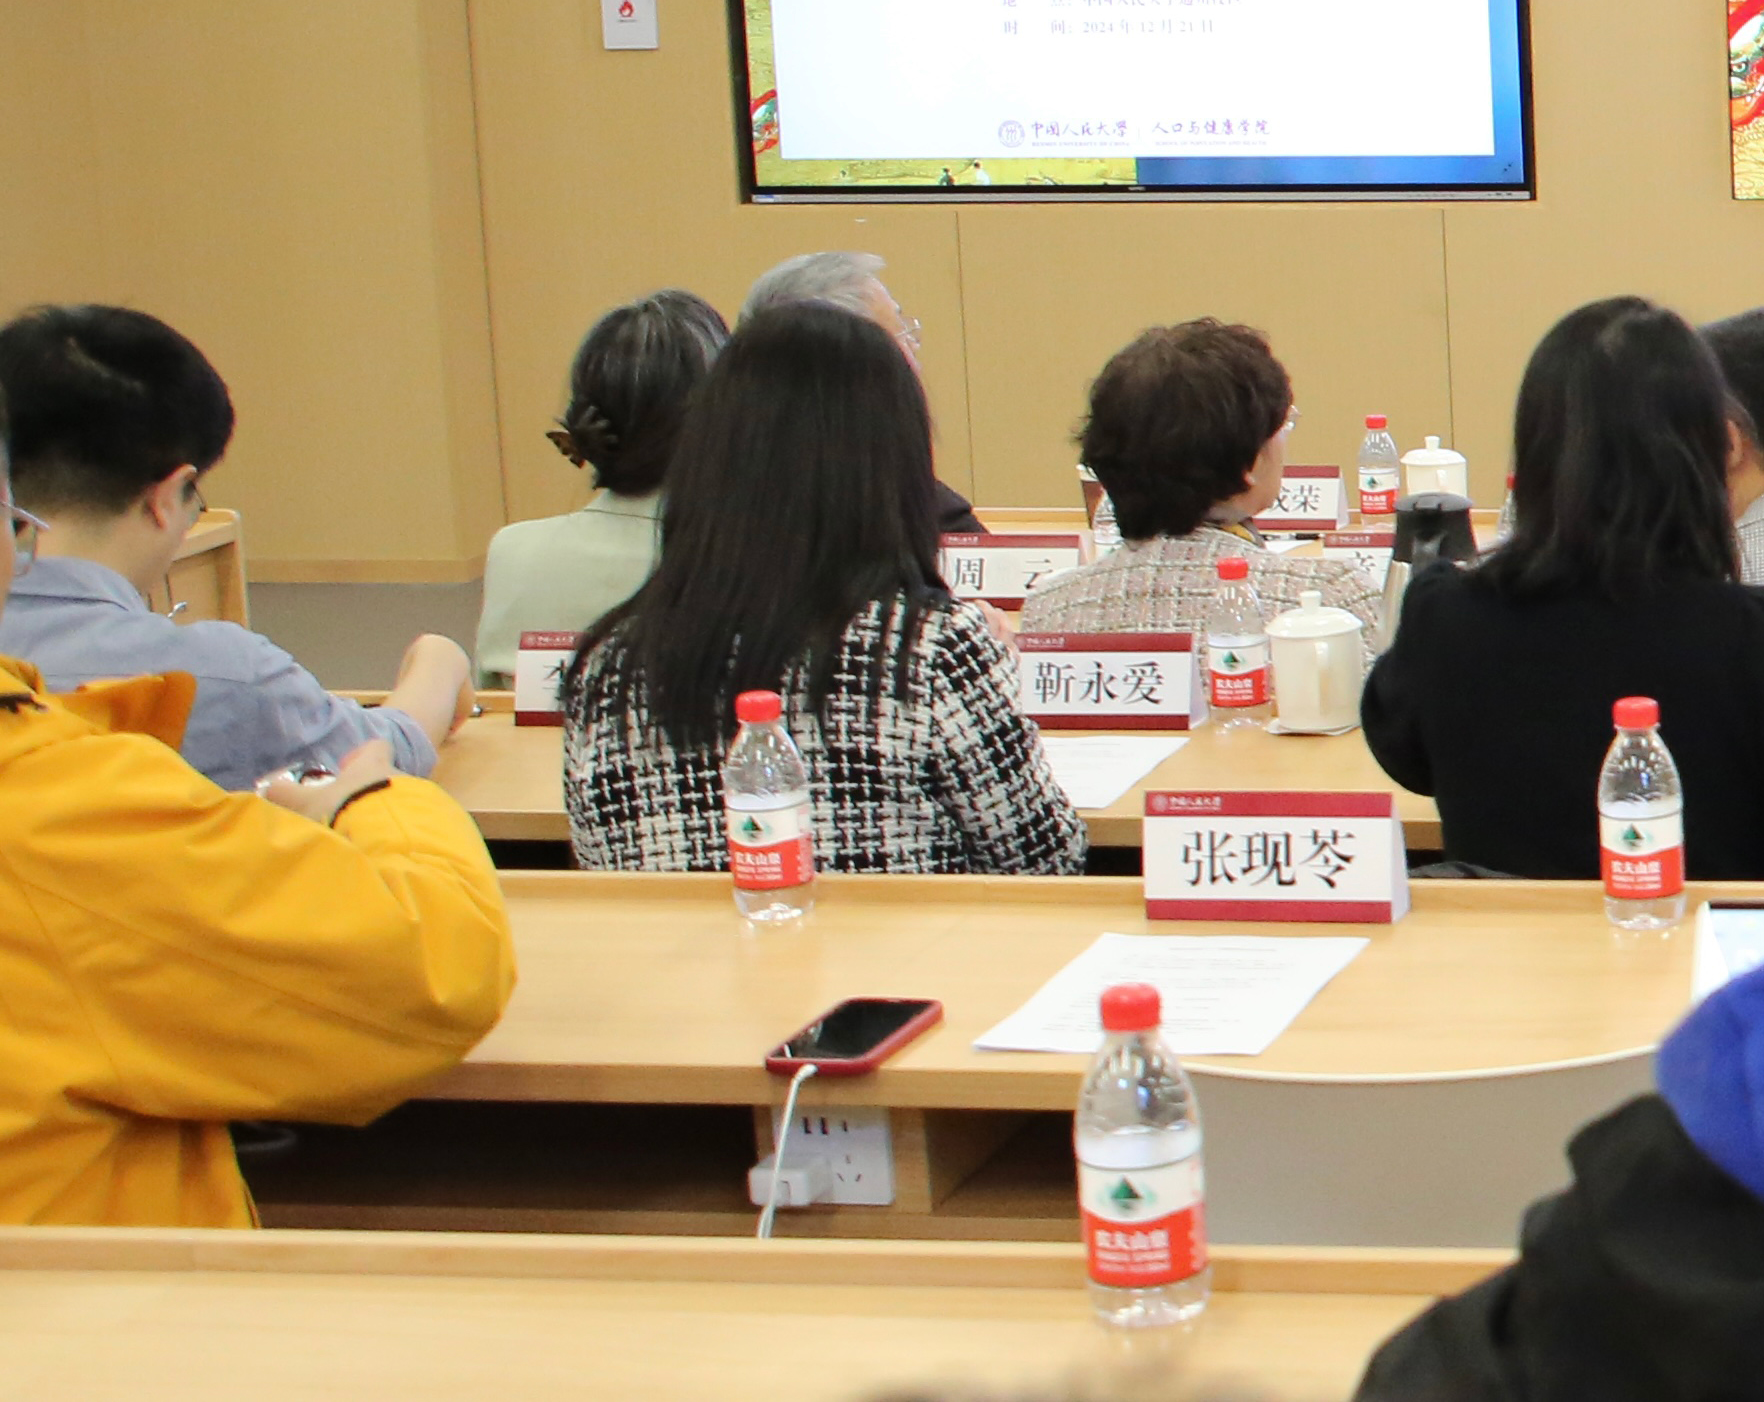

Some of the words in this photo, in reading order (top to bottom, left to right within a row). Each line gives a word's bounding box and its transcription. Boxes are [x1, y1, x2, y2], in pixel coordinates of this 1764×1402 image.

[1033, 660, 1166, 705] 靳永爱
[1181, 828, 1358, 890] 张现苓
